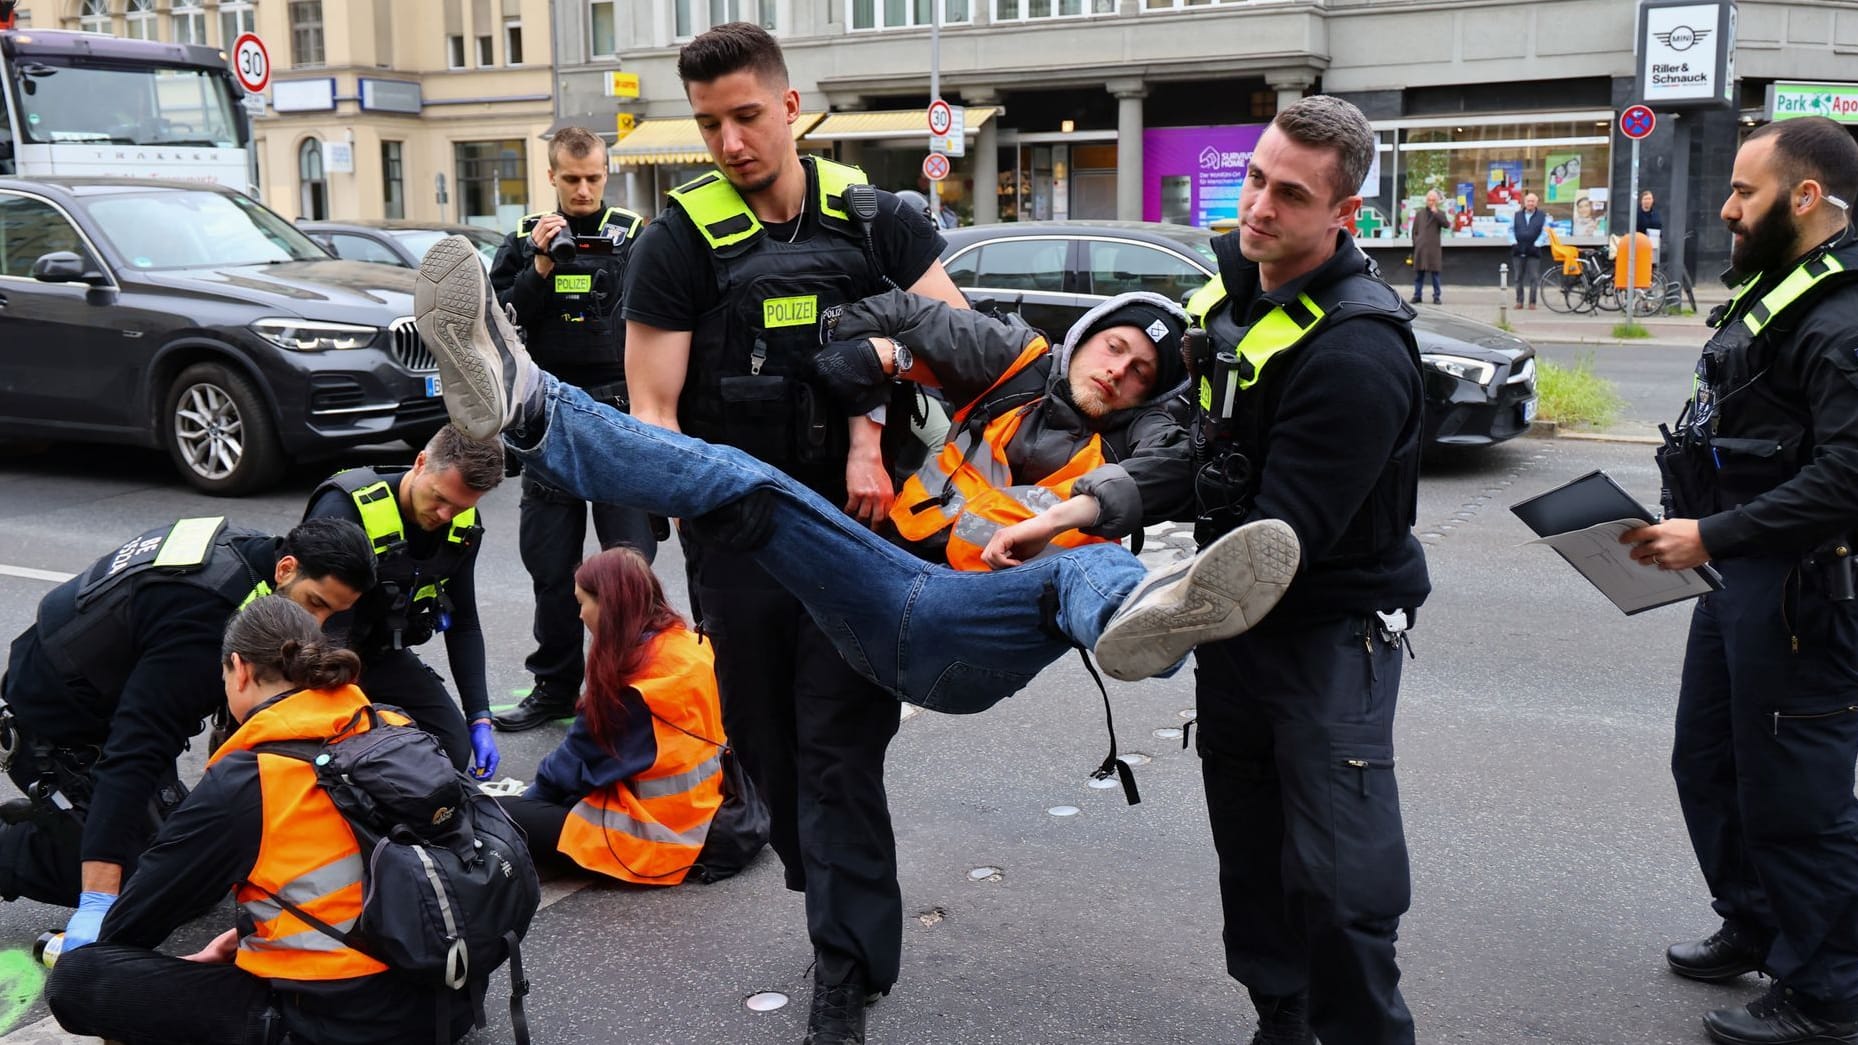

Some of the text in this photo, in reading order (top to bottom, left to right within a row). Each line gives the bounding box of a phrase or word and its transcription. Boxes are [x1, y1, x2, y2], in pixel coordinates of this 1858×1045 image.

[1671, 34, 1693, 42] MINI
[241, 49, 262, 77] 30
[1652, 63, 1689, 73] Riller &
[1652, 73, 1708, 84] Schnauck
[1777, 94, 1858, 116] Park Apo
[933, 110, 947, 126] 30
[557, 278, 589, 290] POLIZEI
[767, 301, 814, 323] POLIZEI
